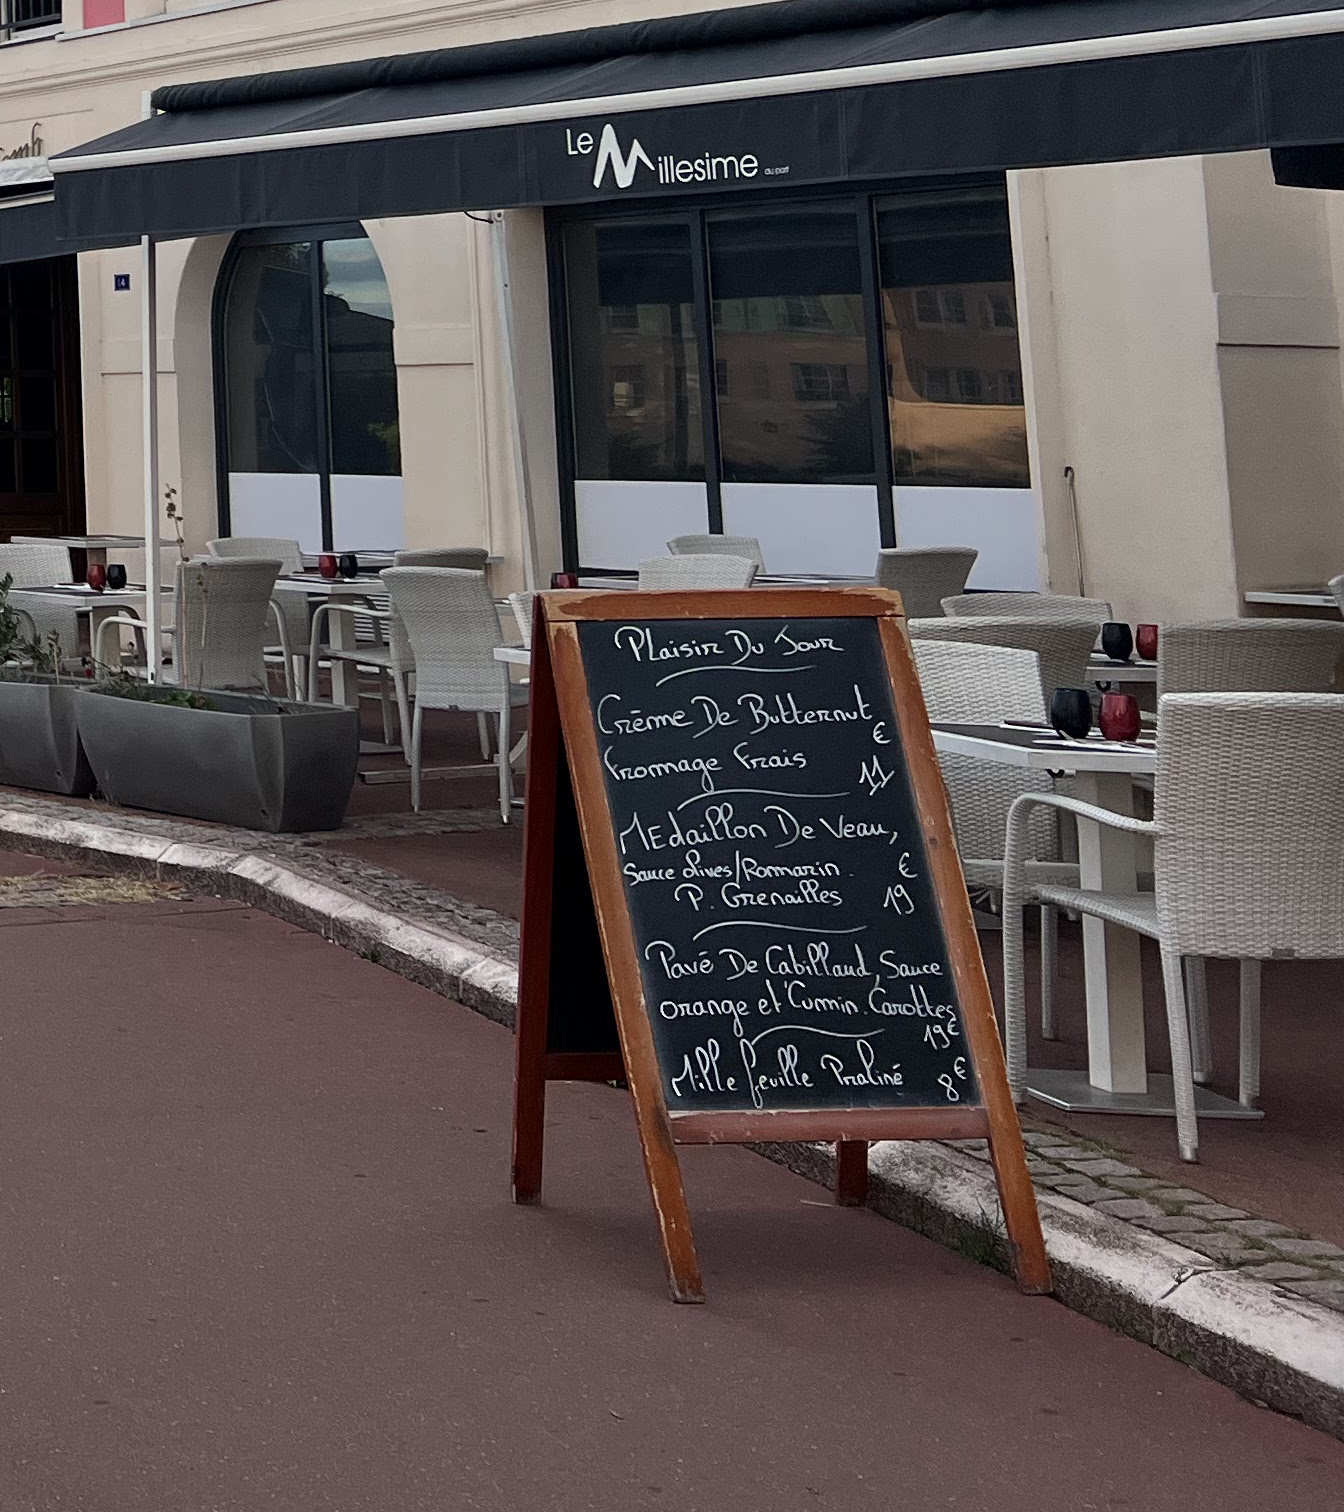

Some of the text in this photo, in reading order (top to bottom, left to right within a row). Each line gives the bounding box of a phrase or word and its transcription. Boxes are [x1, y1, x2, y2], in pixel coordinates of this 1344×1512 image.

[566, 123, 759, 189] Le Millesime
[724, 629, 764, 666] Du
[774, 624, 845, 656] Jour
[690, 695, 739, 739] De
[737, 684, 873, 735] Butternut
[763, 805, 816, 849] De
[622, 862, 677, 887] Sauce
[720, 879, 844, 909] Grenailles
[718, 948, 760, 981] De
[879, 949, 944, 979] Sauce
[758, 978, 782, 1016] et
[868, 984, 958, 1022] Carottes
[671, 1038, 905, 1111] Mille feuille Praliné
